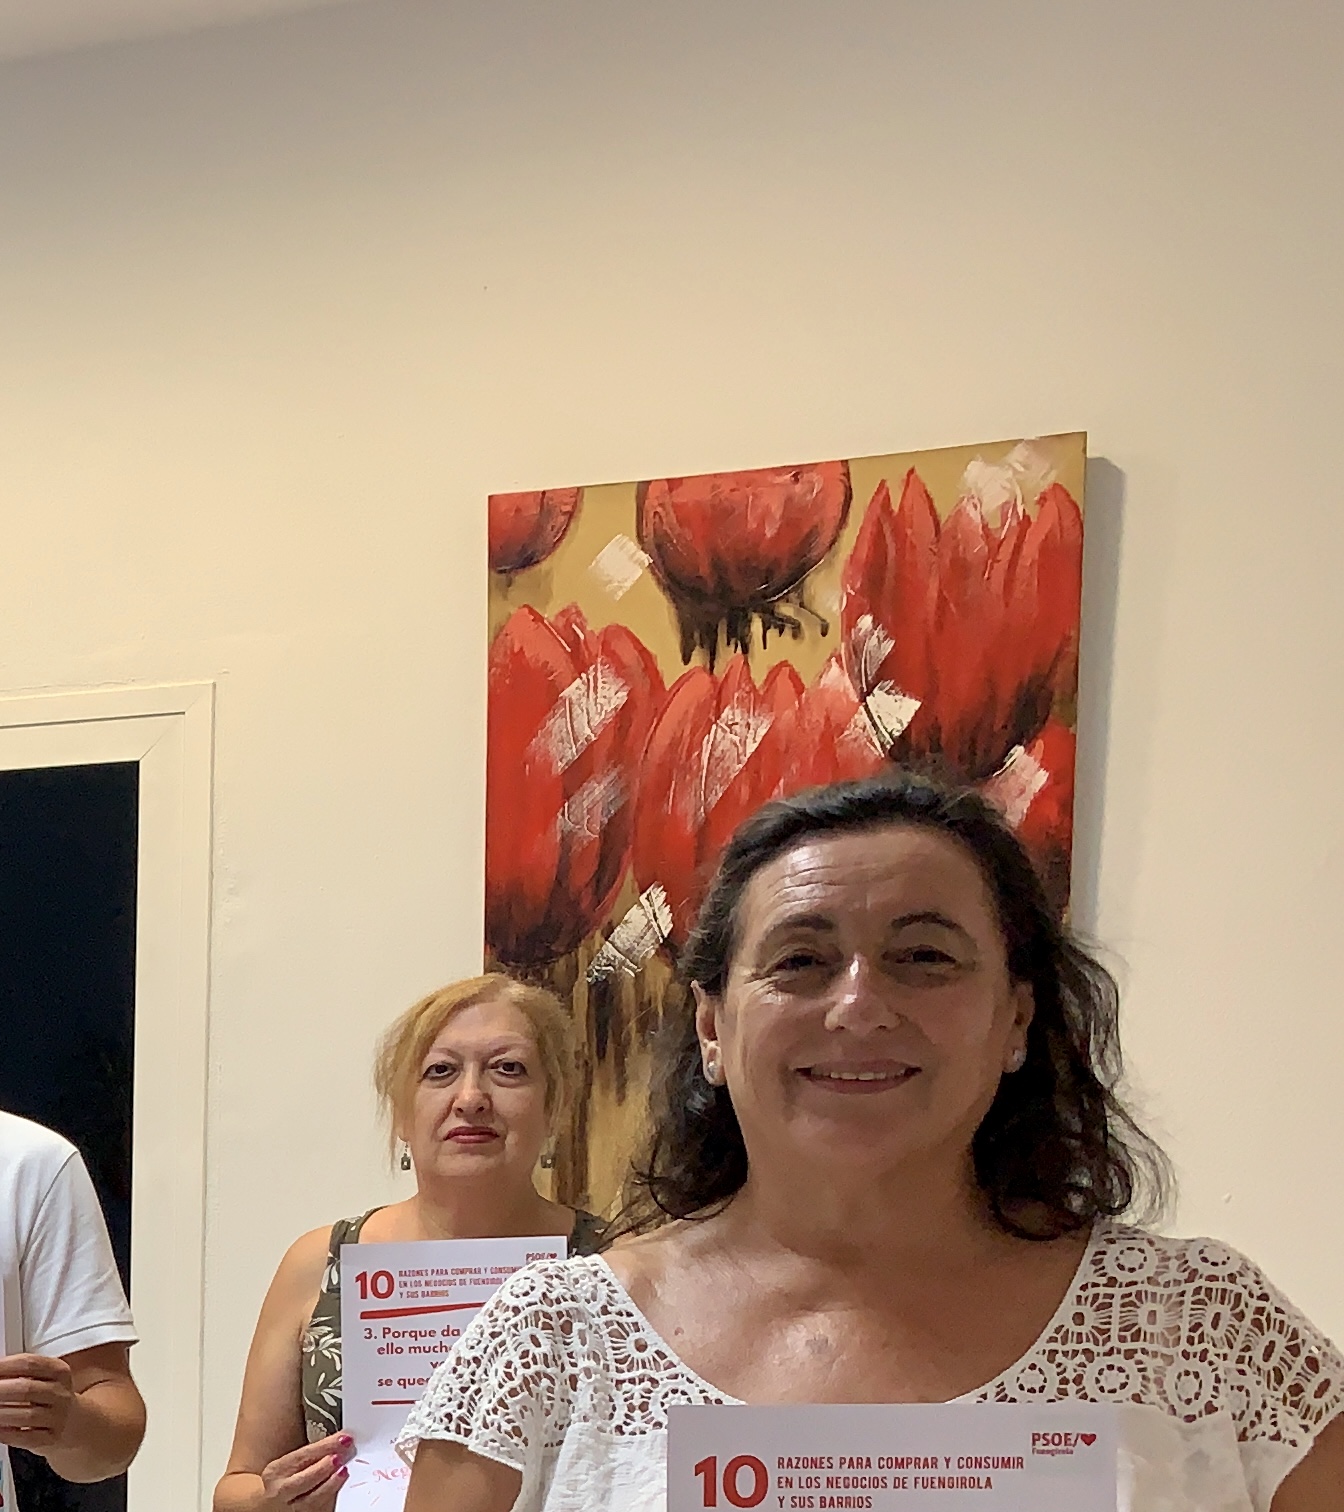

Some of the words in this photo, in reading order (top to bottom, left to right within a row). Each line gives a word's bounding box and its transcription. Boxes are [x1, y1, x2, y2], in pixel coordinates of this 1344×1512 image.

[355, 1269, 395, 1300] 10
[363, 1327, 378, 1340] 3.
[382, 1326, 437, 1342] Porque
[440, 1324, 461, 1338] da
[376, 1341, 405, 1356] ello
[408, 1340, 452, 1355] much
[377, 1378, 393, 1387] se
[694, 1454, 769, 1509] 10
[777, 1495, 785, 1509] Y
[790, 1495, 815, 1509] SUS
[819, 1495, 873, 1509] BARRIOS
